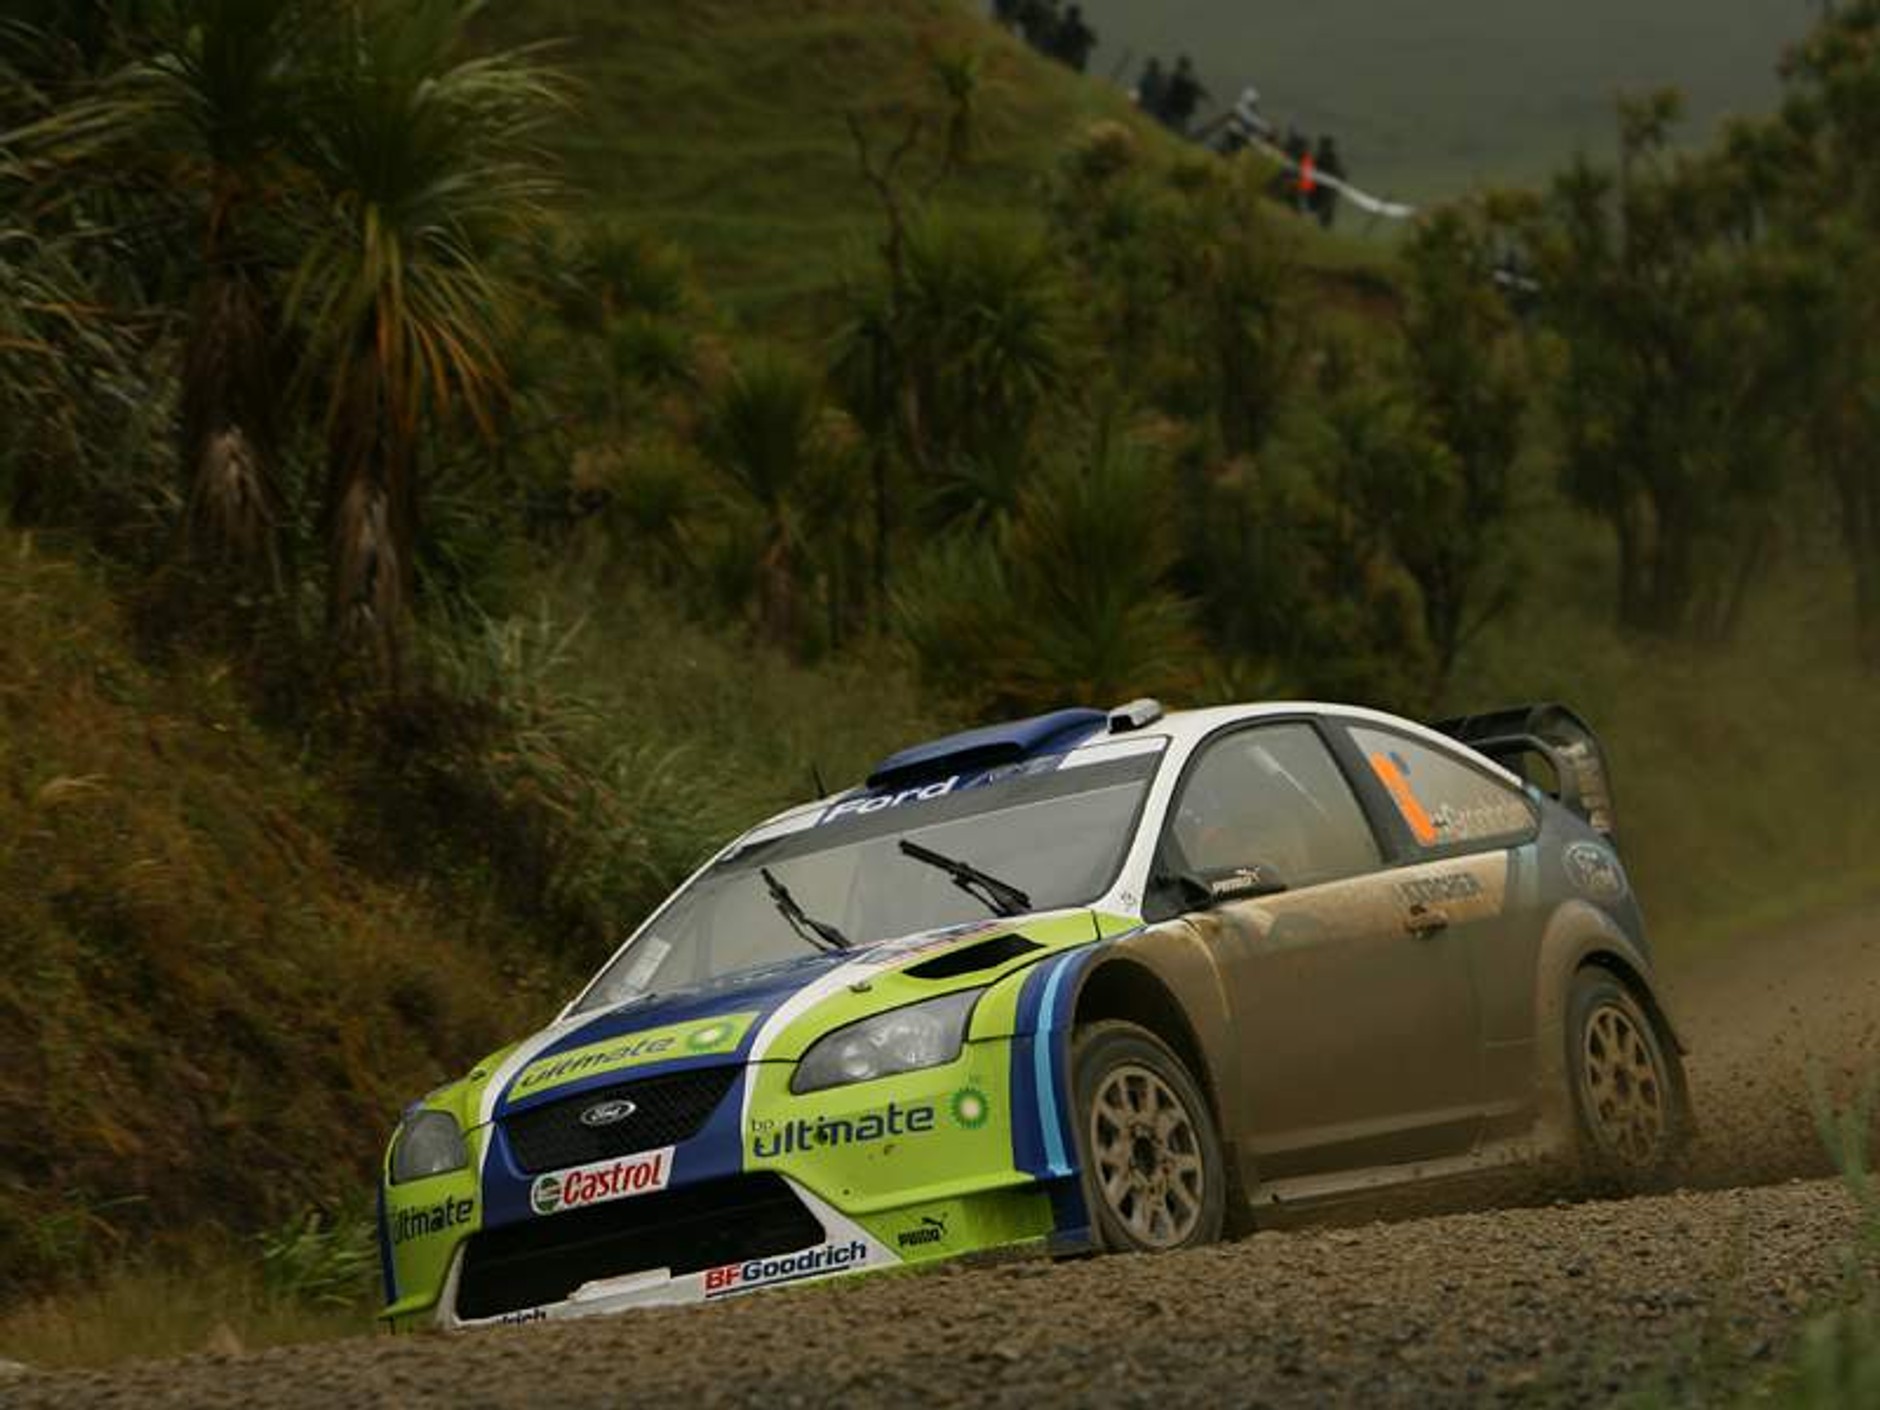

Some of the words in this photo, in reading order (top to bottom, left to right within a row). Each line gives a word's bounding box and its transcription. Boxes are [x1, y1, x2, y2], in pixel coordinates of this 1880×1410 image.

[820, 775, 960, 826] Ford
[521, 1037, 676, 1087] ultimate
[754, 1102, 934, 1158] ultimate
[563, 1156, 662, 1205] Castrol
[706, 1241, 867, 1290] BFGoodrich
